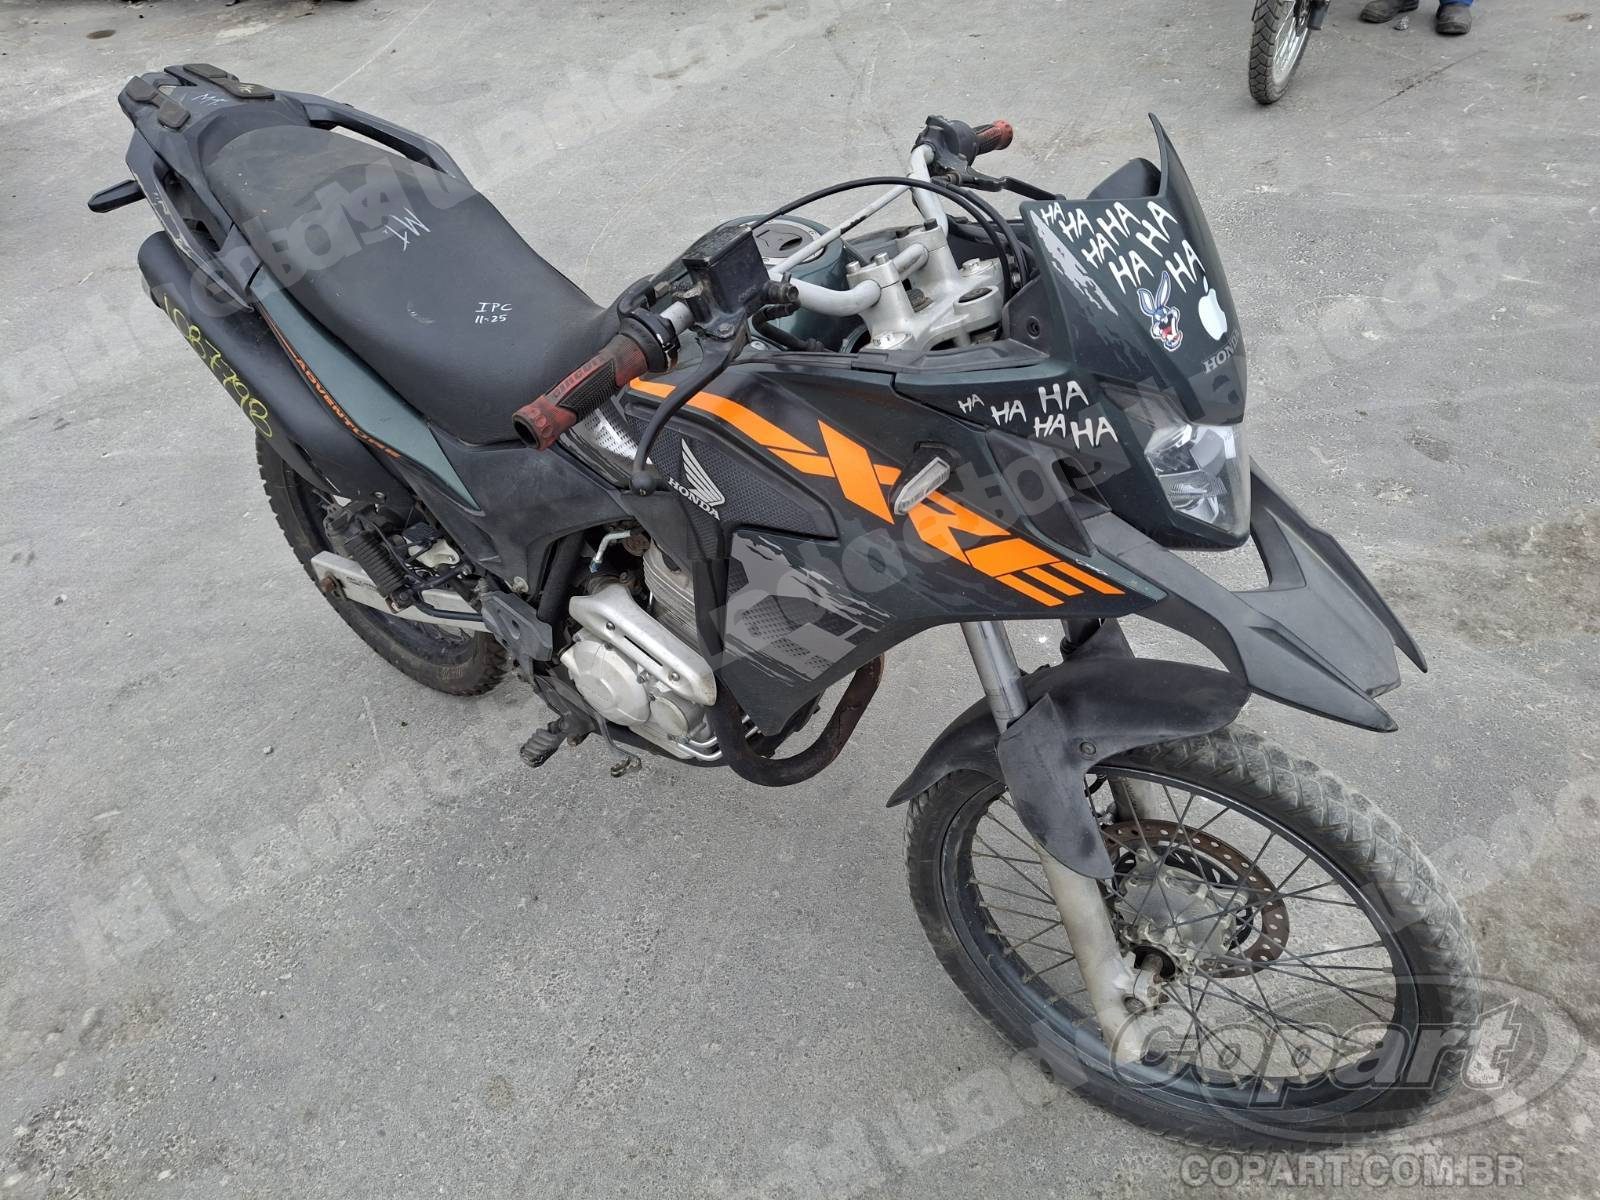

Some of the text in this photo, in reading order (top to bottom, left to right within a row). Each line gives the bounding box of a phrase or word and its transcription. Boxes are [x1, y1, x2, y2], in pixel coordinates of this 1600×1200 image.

[1040, 202, 1066, 226] HA
[1058, 208, 1095, 243] HA
[1096, 201, 1142, 246] HA
[1135, 200, 1178, 258] HA
[1081, 232, 1117, 269] HA
[1165, 239, 1206, 293] HA
[1109, 250, 1155, 295] HA
[474, 314, 508, 325] 11-25
[475, 301, 513, 313] IPC
[957, 393, 985, 414] HA
[990, 400, 1027, 426] HA
[1037, 380, 1090, 414] HA
[1033, 413, 1067, 438] HA
[1070, 416, 1119, 450] HA
[667, 476, 721, 521] HONDA
